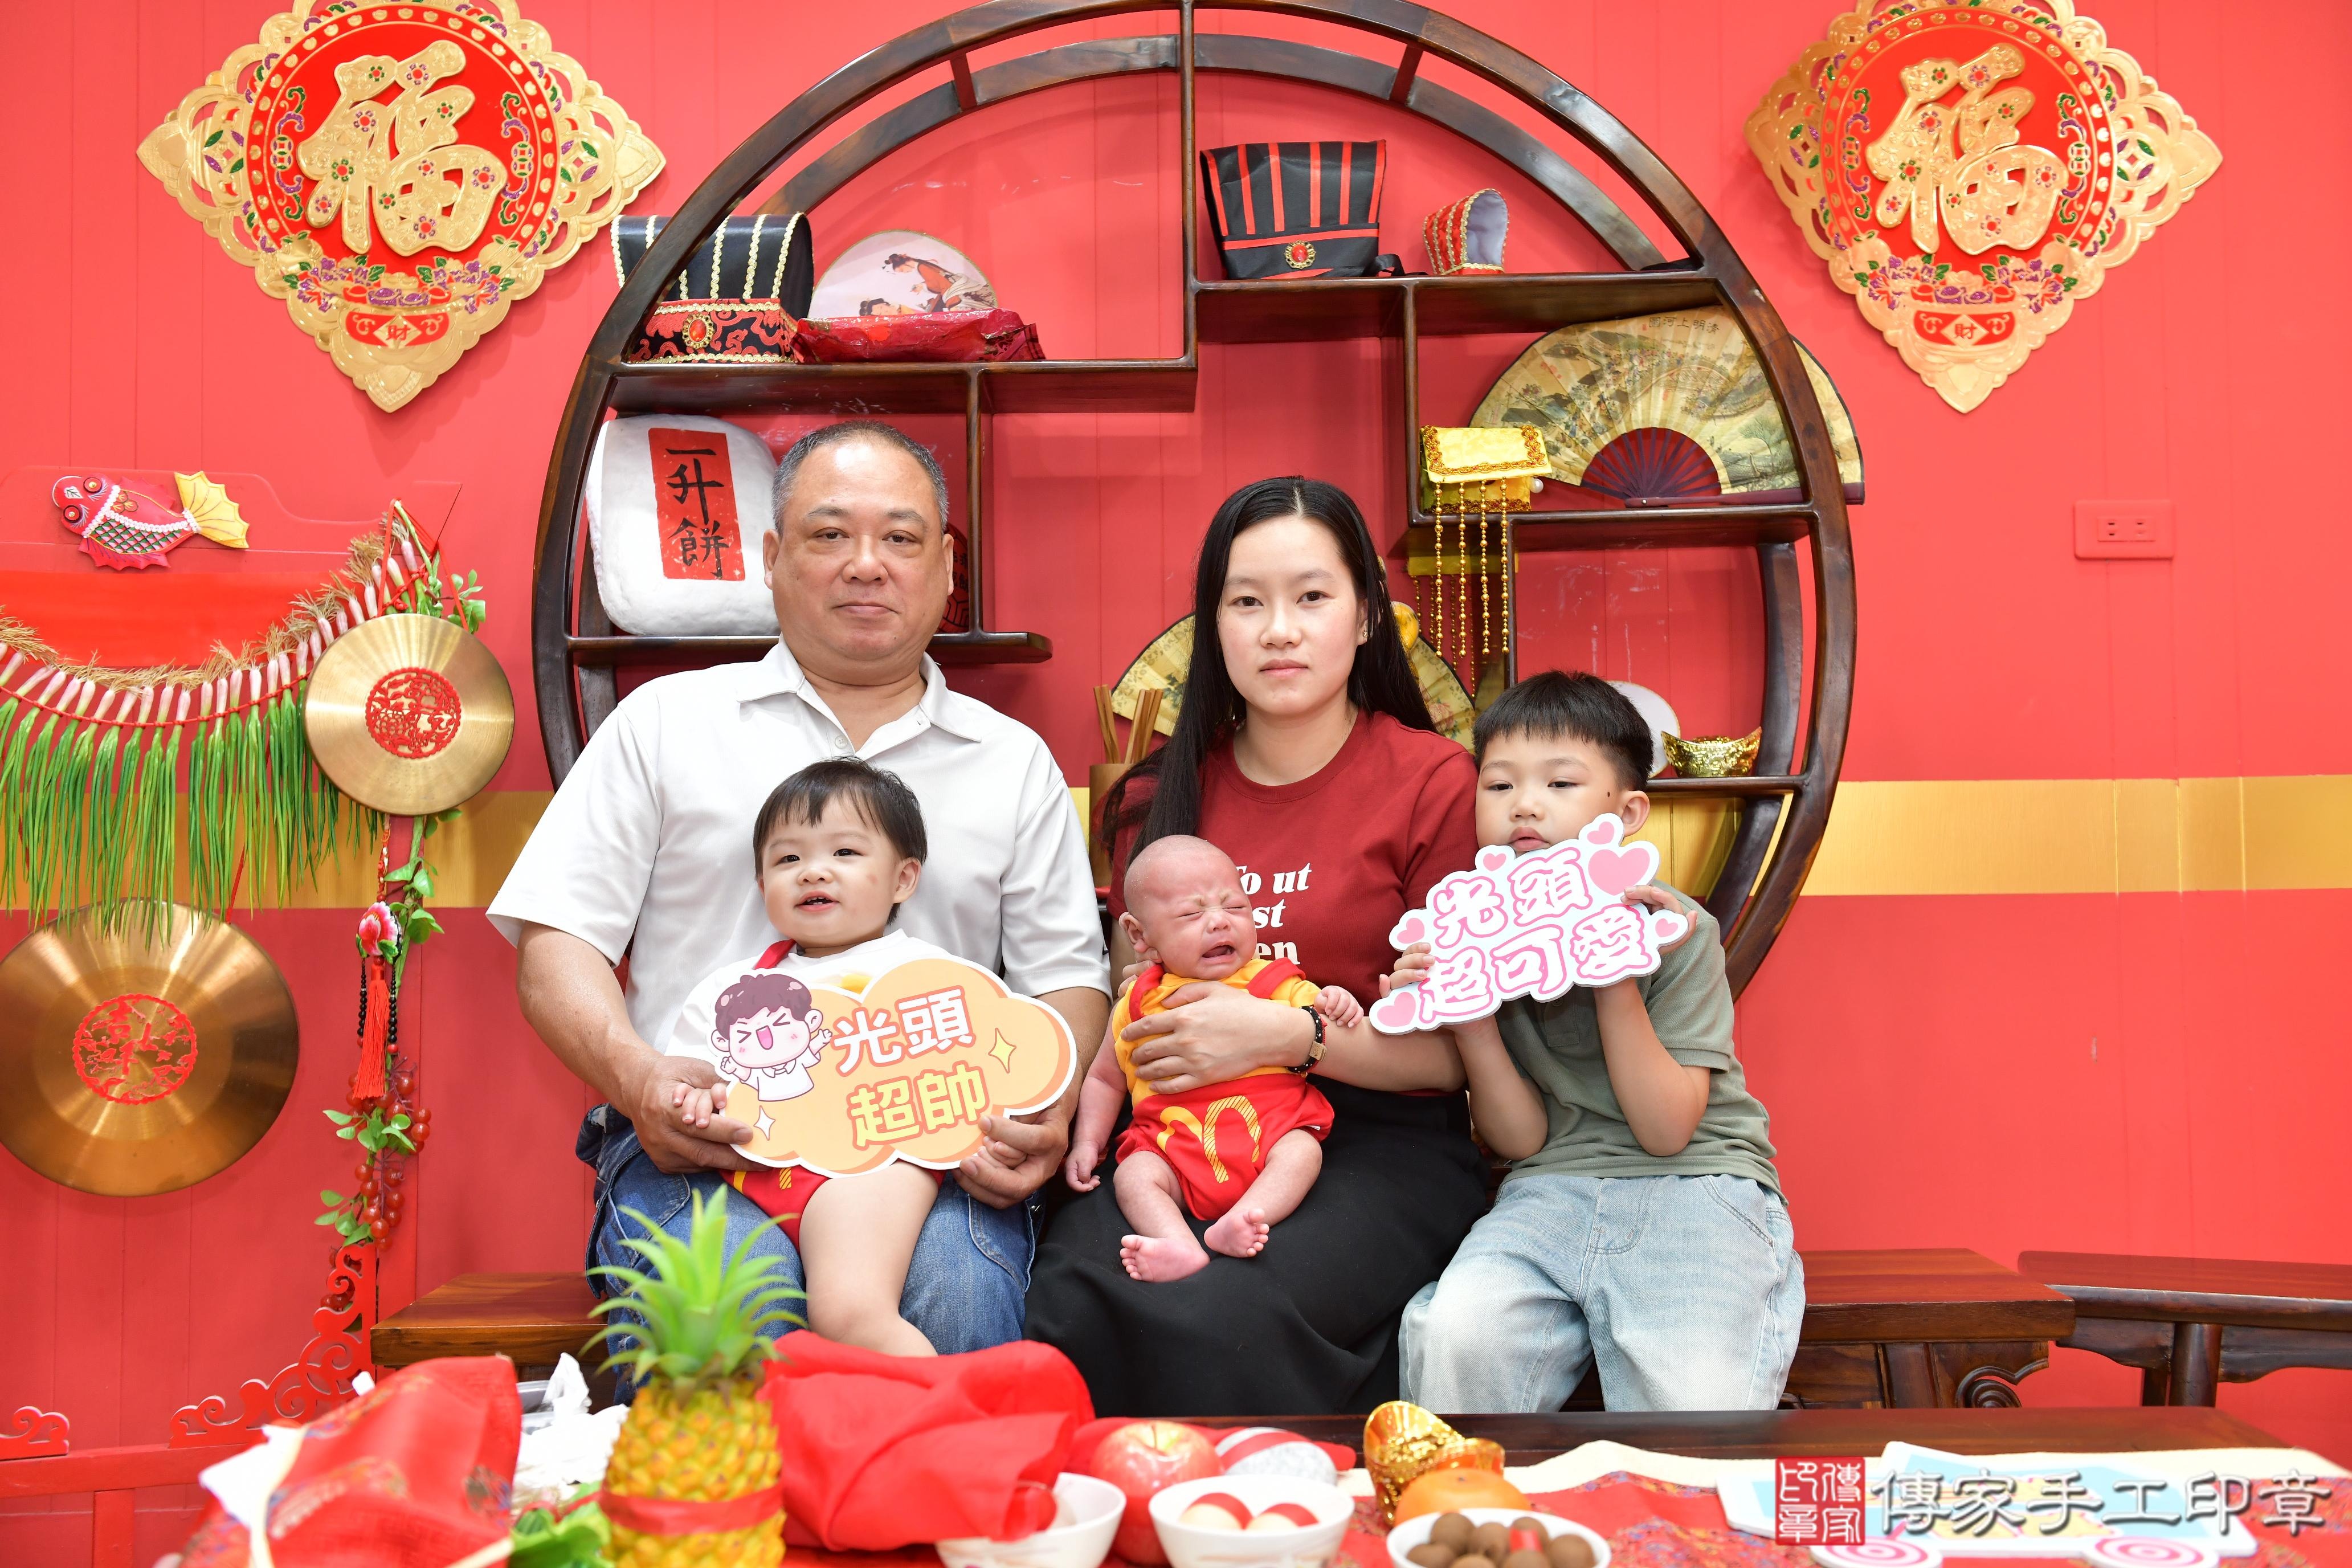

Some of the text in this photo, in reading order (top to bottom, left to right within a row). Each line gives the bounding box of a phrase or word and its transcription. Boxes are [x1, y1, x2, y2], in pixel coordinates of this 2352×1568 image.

[297, 39, 507, 256] 福
[1867, 43, 2068, 255] 福
[386, 325, 410, 341] 財
[1954, 324, 1977, 339] 財
[665, 448, 730, 580] 一升餅
[1252, 899, 1286, 929] st
[1434, 847, 1592, 949] 光頭
[831, 987, 974, 1075] 光頭
[848, 1062, 989, 1149] 超帥
